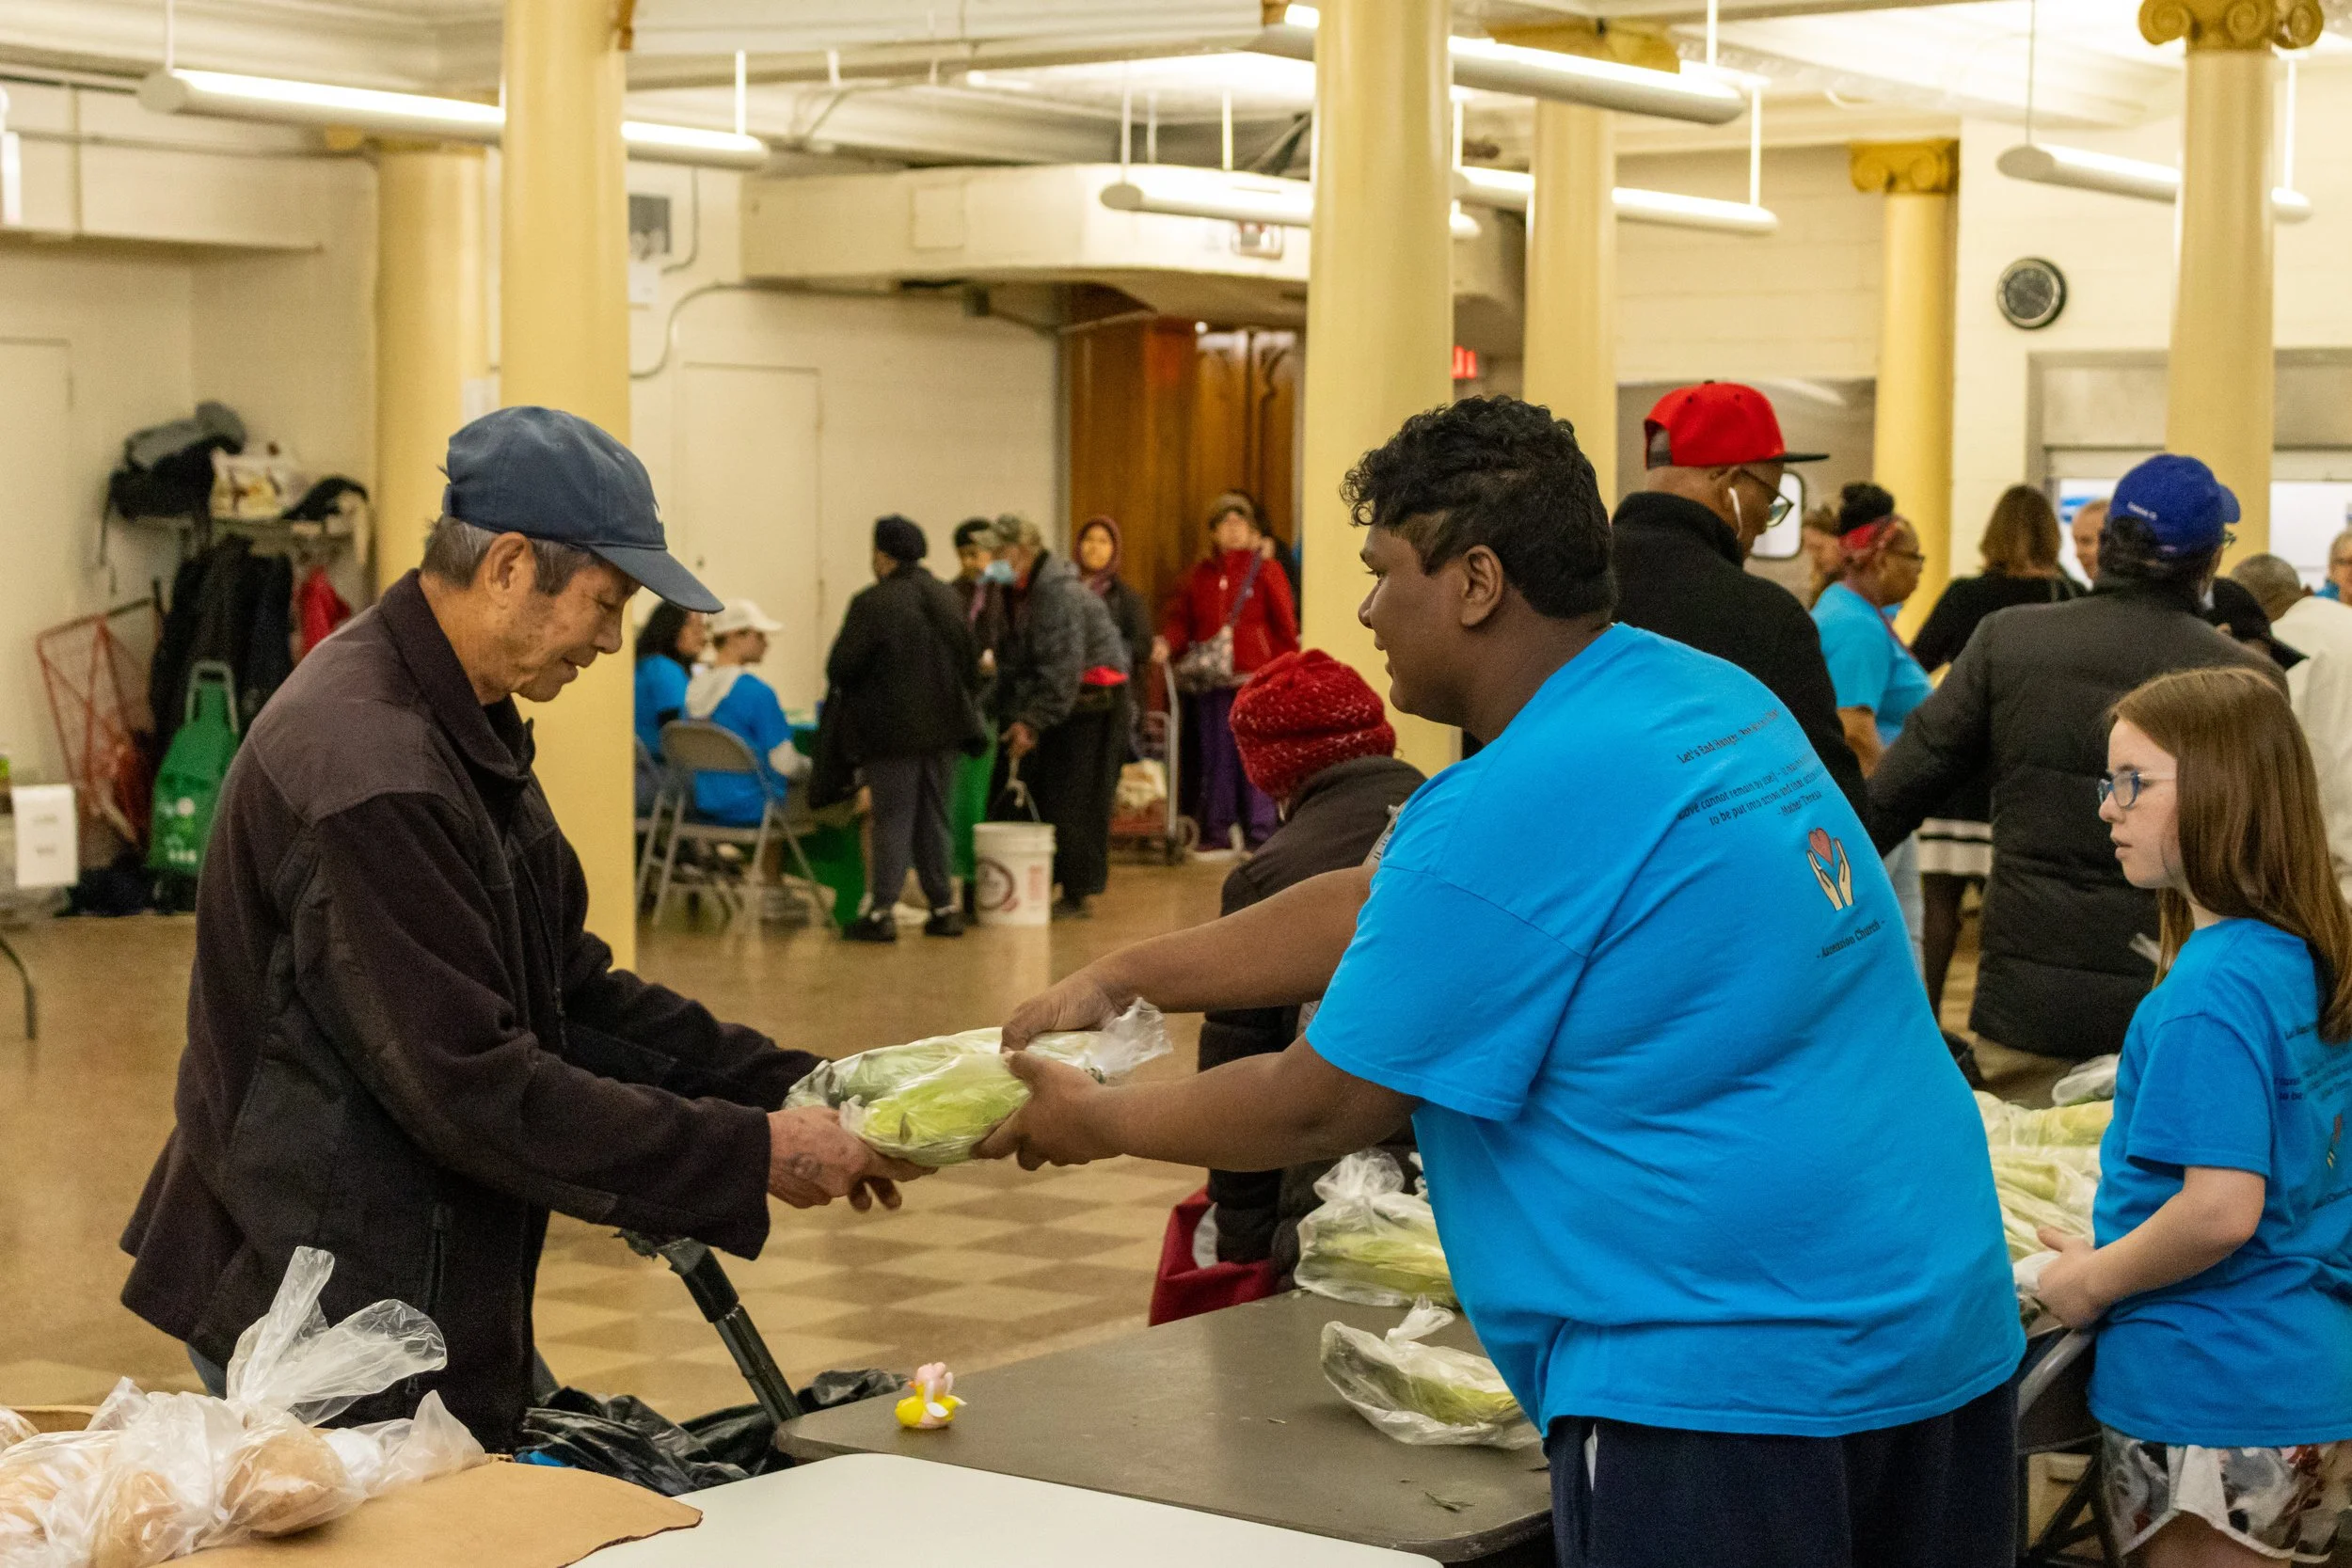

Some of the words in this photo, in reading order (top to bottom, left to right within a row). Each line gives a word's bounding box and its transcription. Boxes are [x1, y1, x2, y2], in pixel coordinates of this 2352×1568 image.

[1677, 749, 1700, 764] Let's
[1697, 741, 1716, 755] End
[1701, 792, 1729, 811] cannot
[1729, 783, 1756, 800] remain
[1709, 815, 1720, 826] to
[1719, 809, 1731, 822] be
[1731, 804, 1747, 819] put
[1746, 799, 1762, 813] into
[1821, 935, 1856, 958] Ascension
[1854, 918, 1881, 942] Church
